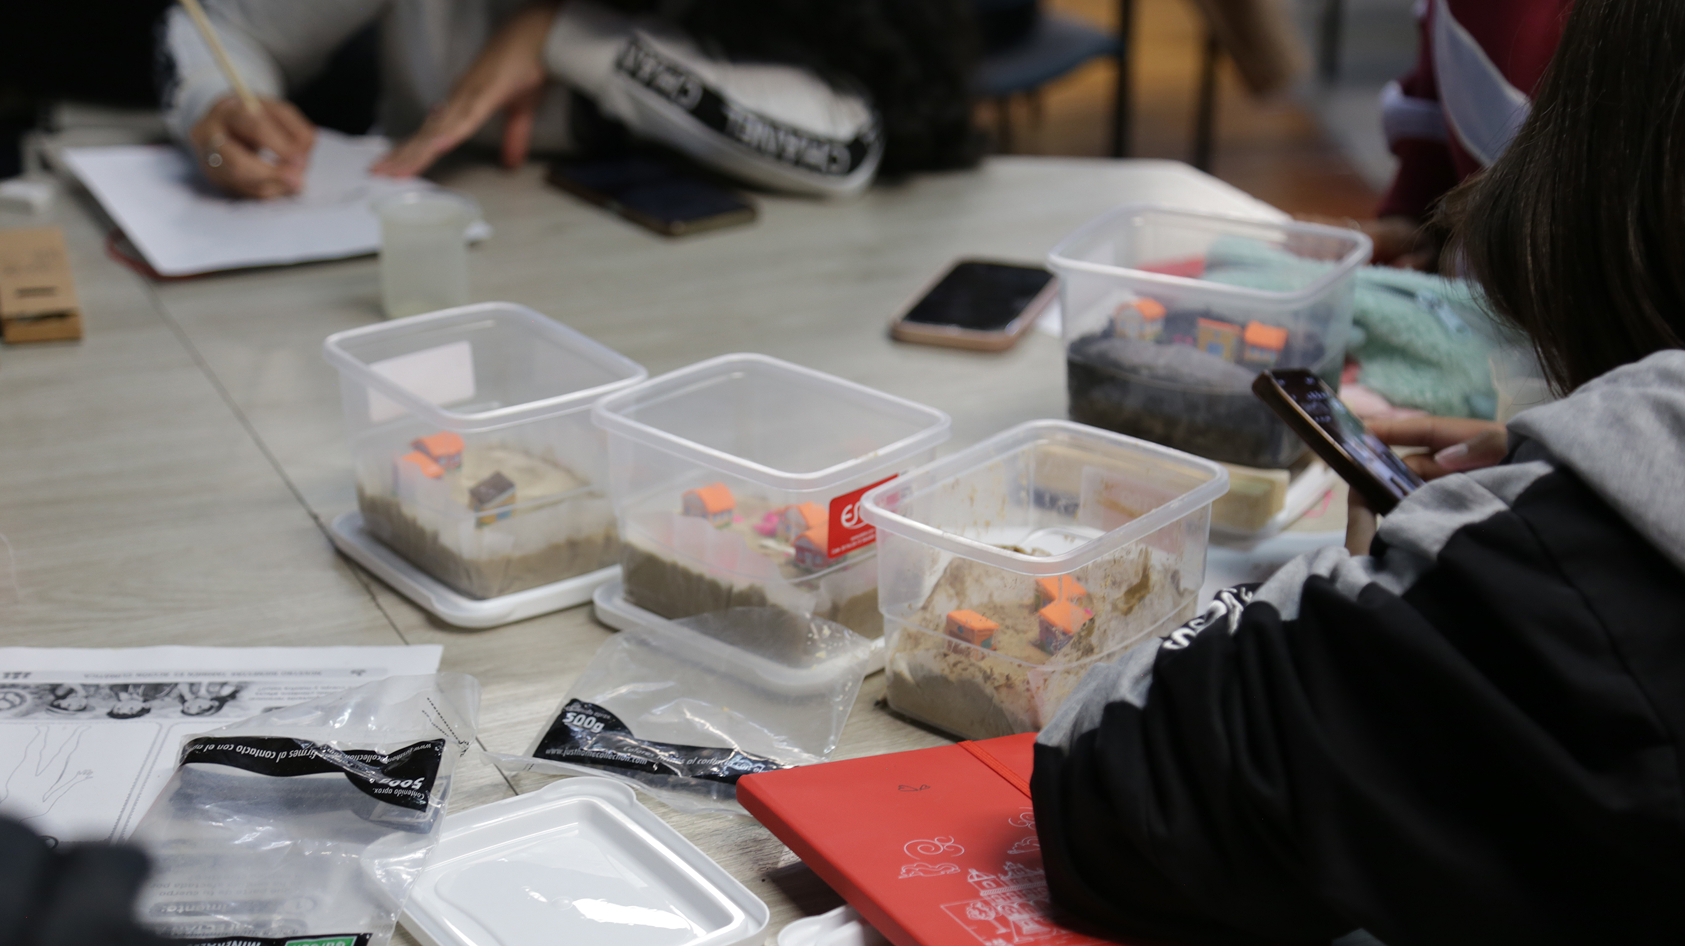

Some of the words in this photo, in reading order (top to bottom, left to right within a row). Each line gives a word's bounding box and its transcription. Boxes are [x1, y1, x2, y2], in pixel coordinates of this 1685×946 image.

[562, 711, 606, 734] 500g
[202, 743, 217, 753] el
[216, 743, 235, 752] con
[235, 744, 276, 764] contacto
[288, 747, 317, 761] firmes
[275, 751, 288, 764] al
[393, 788, 426, 801] Contenido
